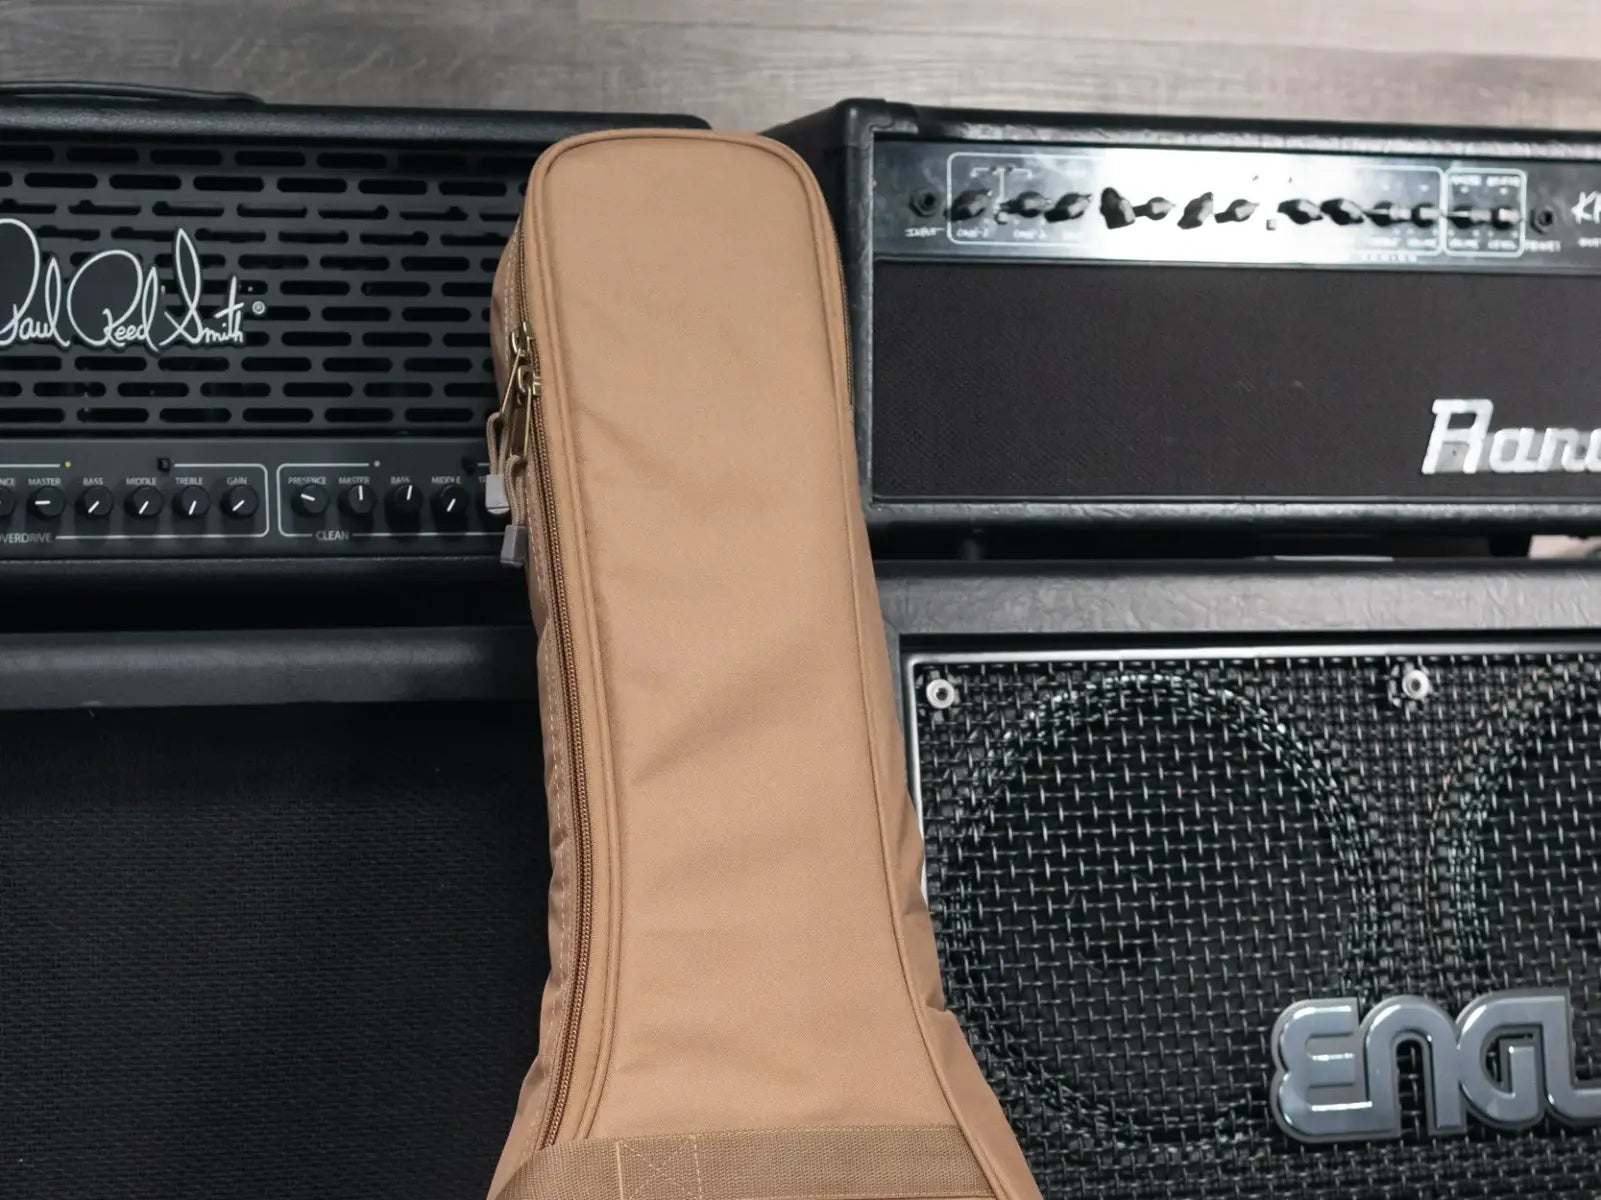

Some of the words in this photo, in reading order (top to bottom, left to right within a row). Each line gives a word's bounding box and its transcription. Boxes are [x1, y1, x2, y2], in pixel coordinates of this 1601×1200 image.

[67, 249, 159, 353] Reed
[28, 477, 61, 486] MASTER
[83, 477, 103, 486] BASS
[126, 477, 157, 486] MIDDLE
[227, 477, 247, 486] GAIN
[0, 532, 52, 544] VERDRIVE
[316, 530, 349, 541] CLEAN
